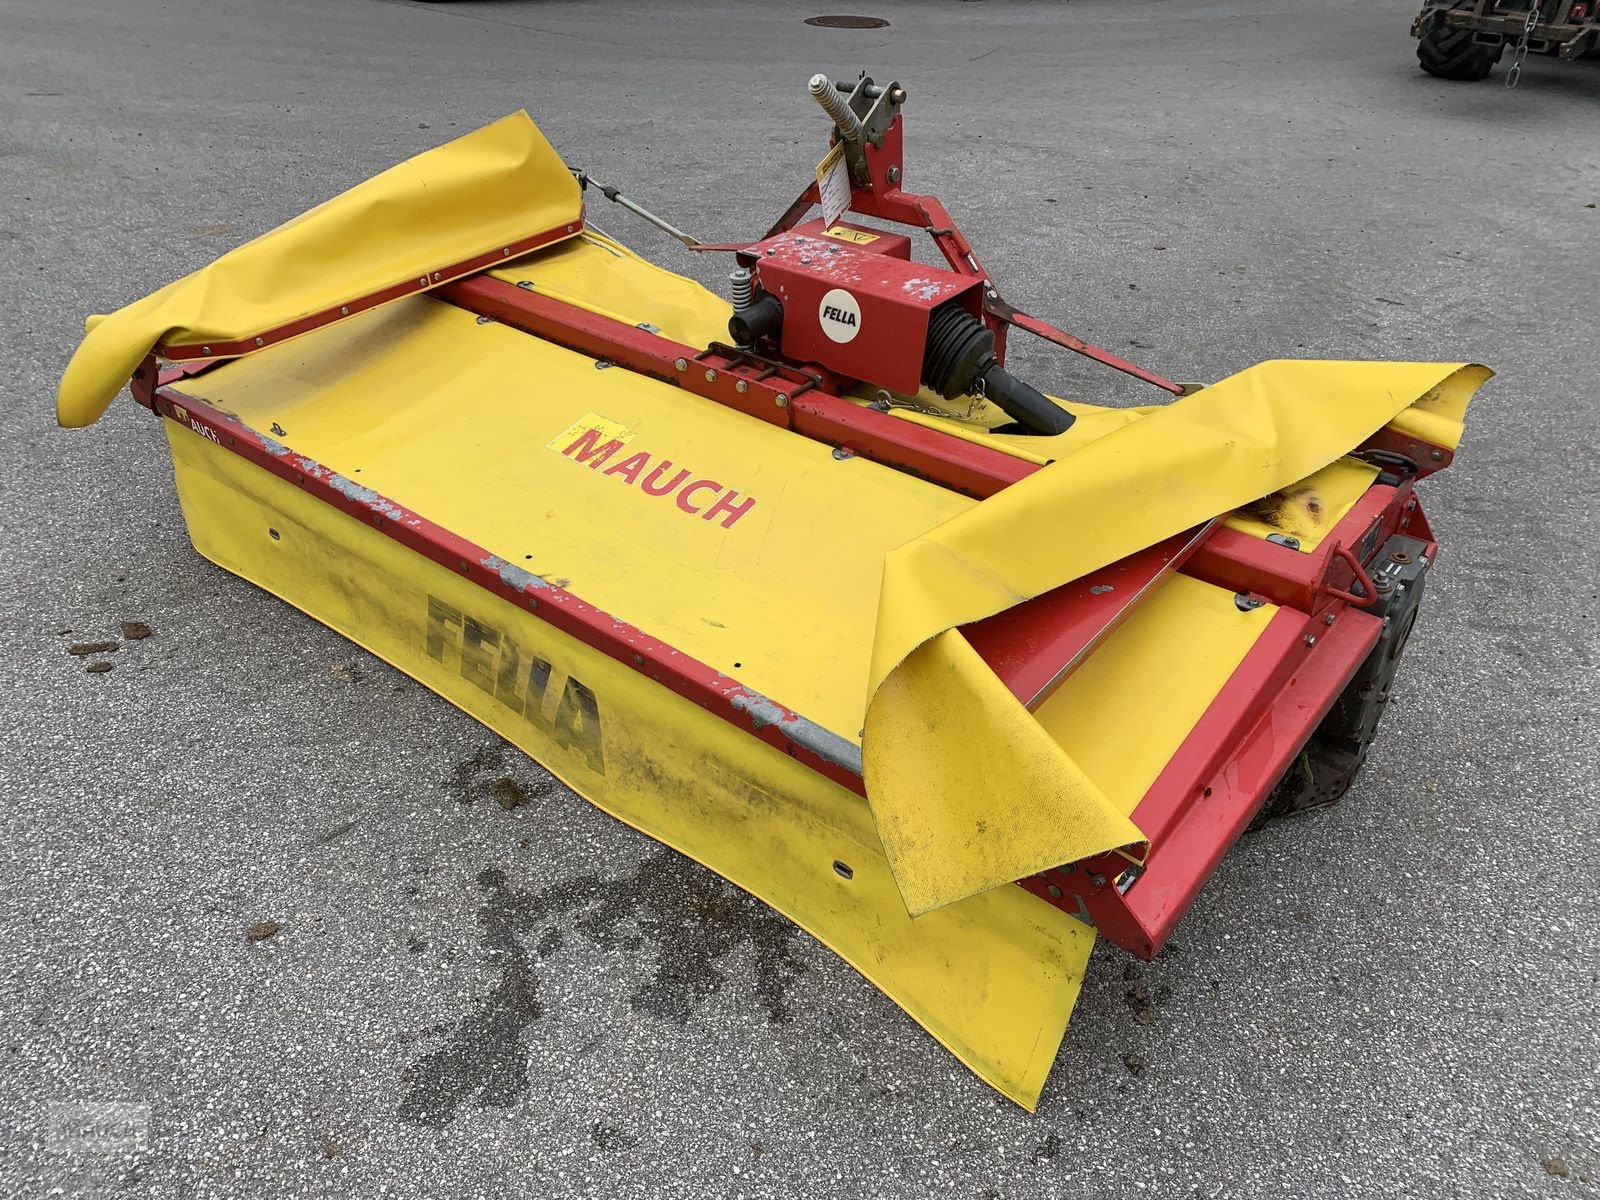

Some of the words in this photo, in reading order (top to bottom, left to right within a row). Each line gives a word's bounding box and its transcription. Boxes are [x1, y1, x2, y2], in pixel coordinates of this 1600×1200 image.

[823, 305, 857, 327] FELLA
[561, 428, 757, 529] MAUCH
[426, 594, 605, 777] FELLA
